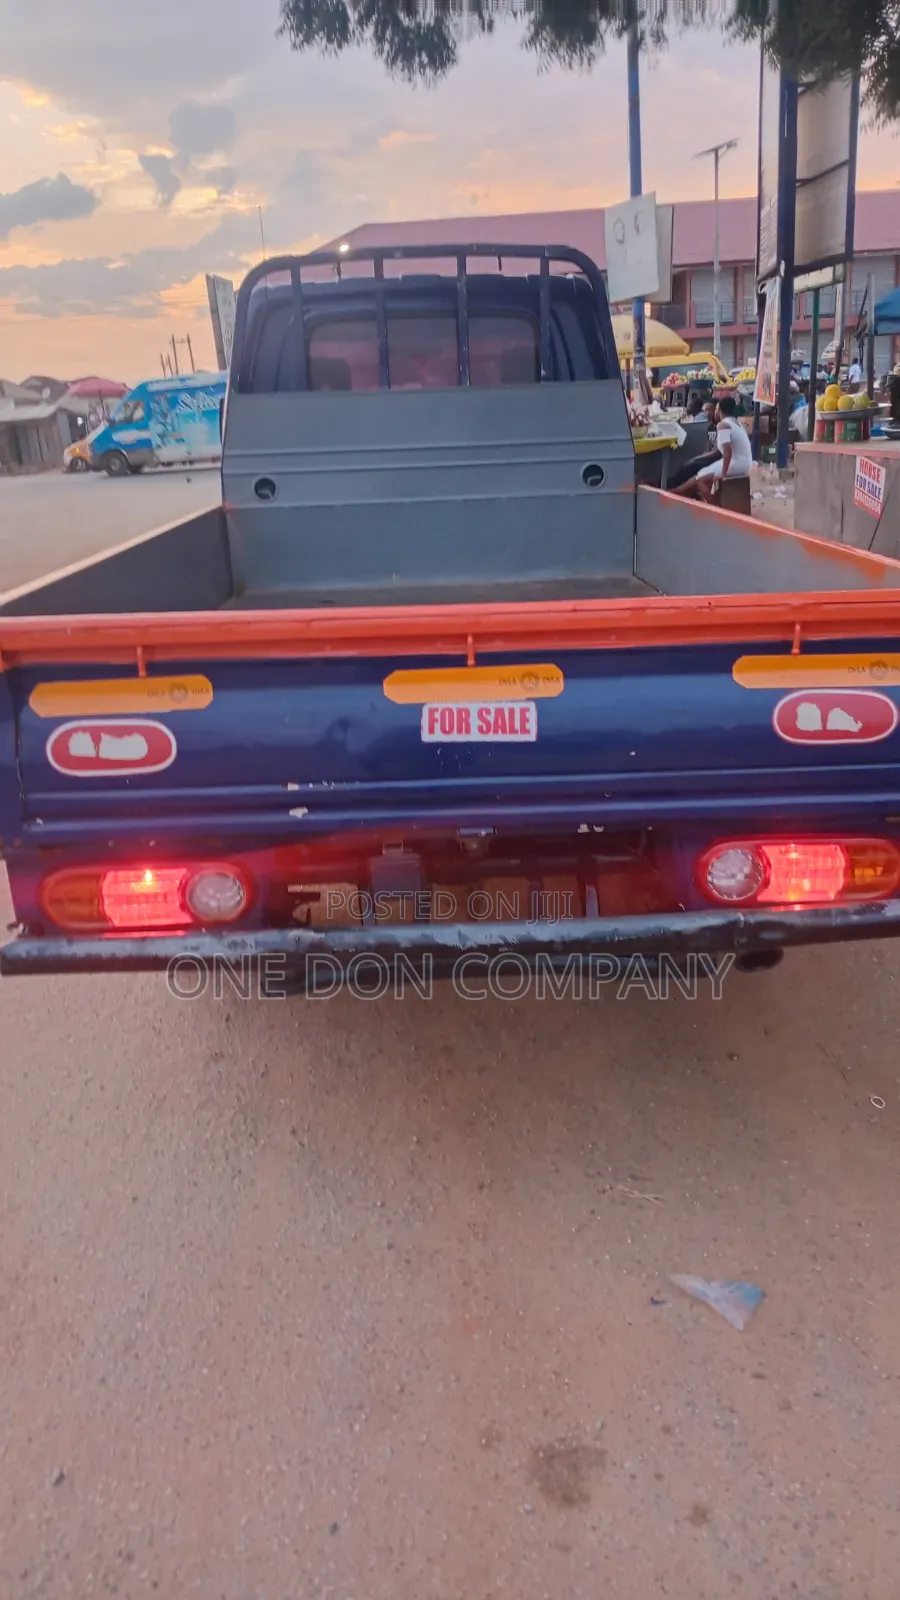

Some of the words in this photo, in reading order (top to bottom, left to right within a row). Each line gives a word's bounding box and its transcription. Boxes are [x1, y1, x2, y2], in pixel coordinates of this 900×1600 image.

[860, 458, 881, 483] HOUSE
[856, 474, 867, 490] FOR
[867, 481, 882, 500] SALE
[428, 707, 471, 735] FOR
[477, 707, 531, 735] SALE
